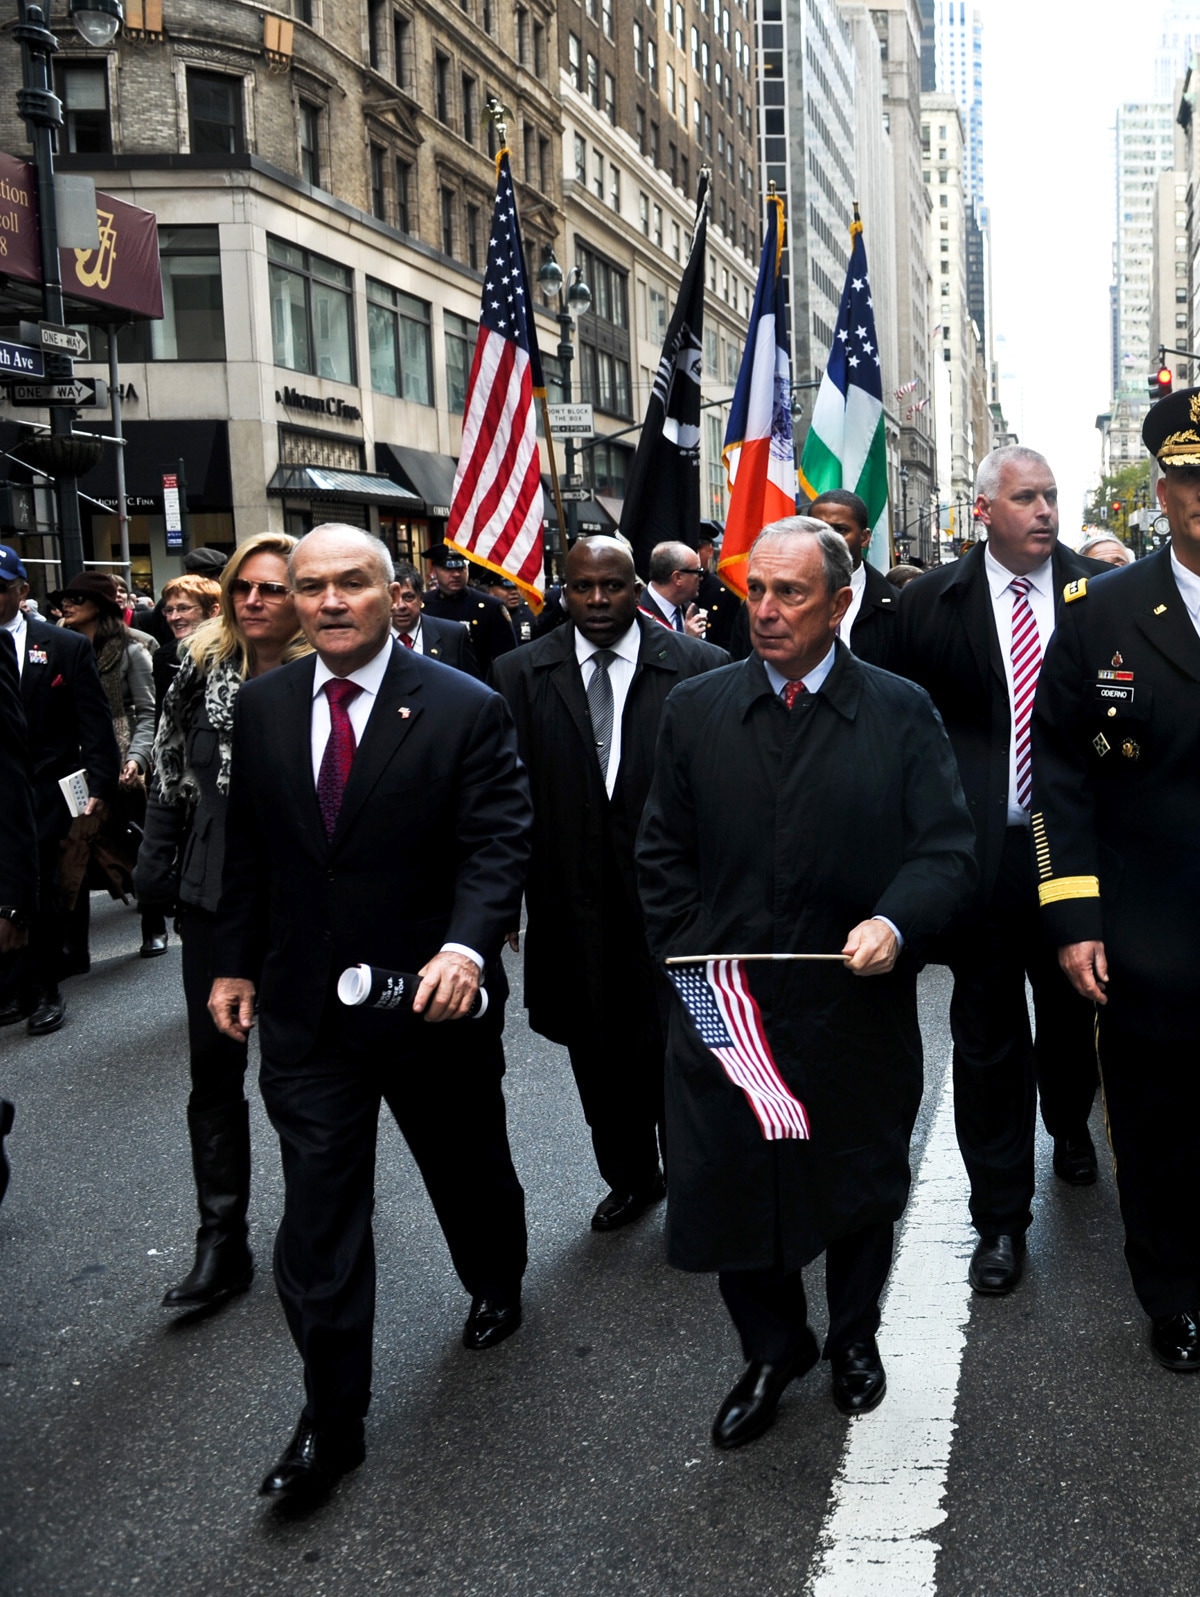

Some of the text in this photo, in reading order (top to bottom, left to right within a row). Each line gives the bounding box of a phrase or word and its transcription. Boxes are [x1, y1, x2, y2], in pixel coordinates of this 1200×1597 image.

[43, 331, 58, 344] ONE
[13, 351, 34, 369] Ave
[18, 387, 40, 398] ONE
[57, 386, 83, 398] WAY
[1101, 689, 1127, 699] ODIERNO
